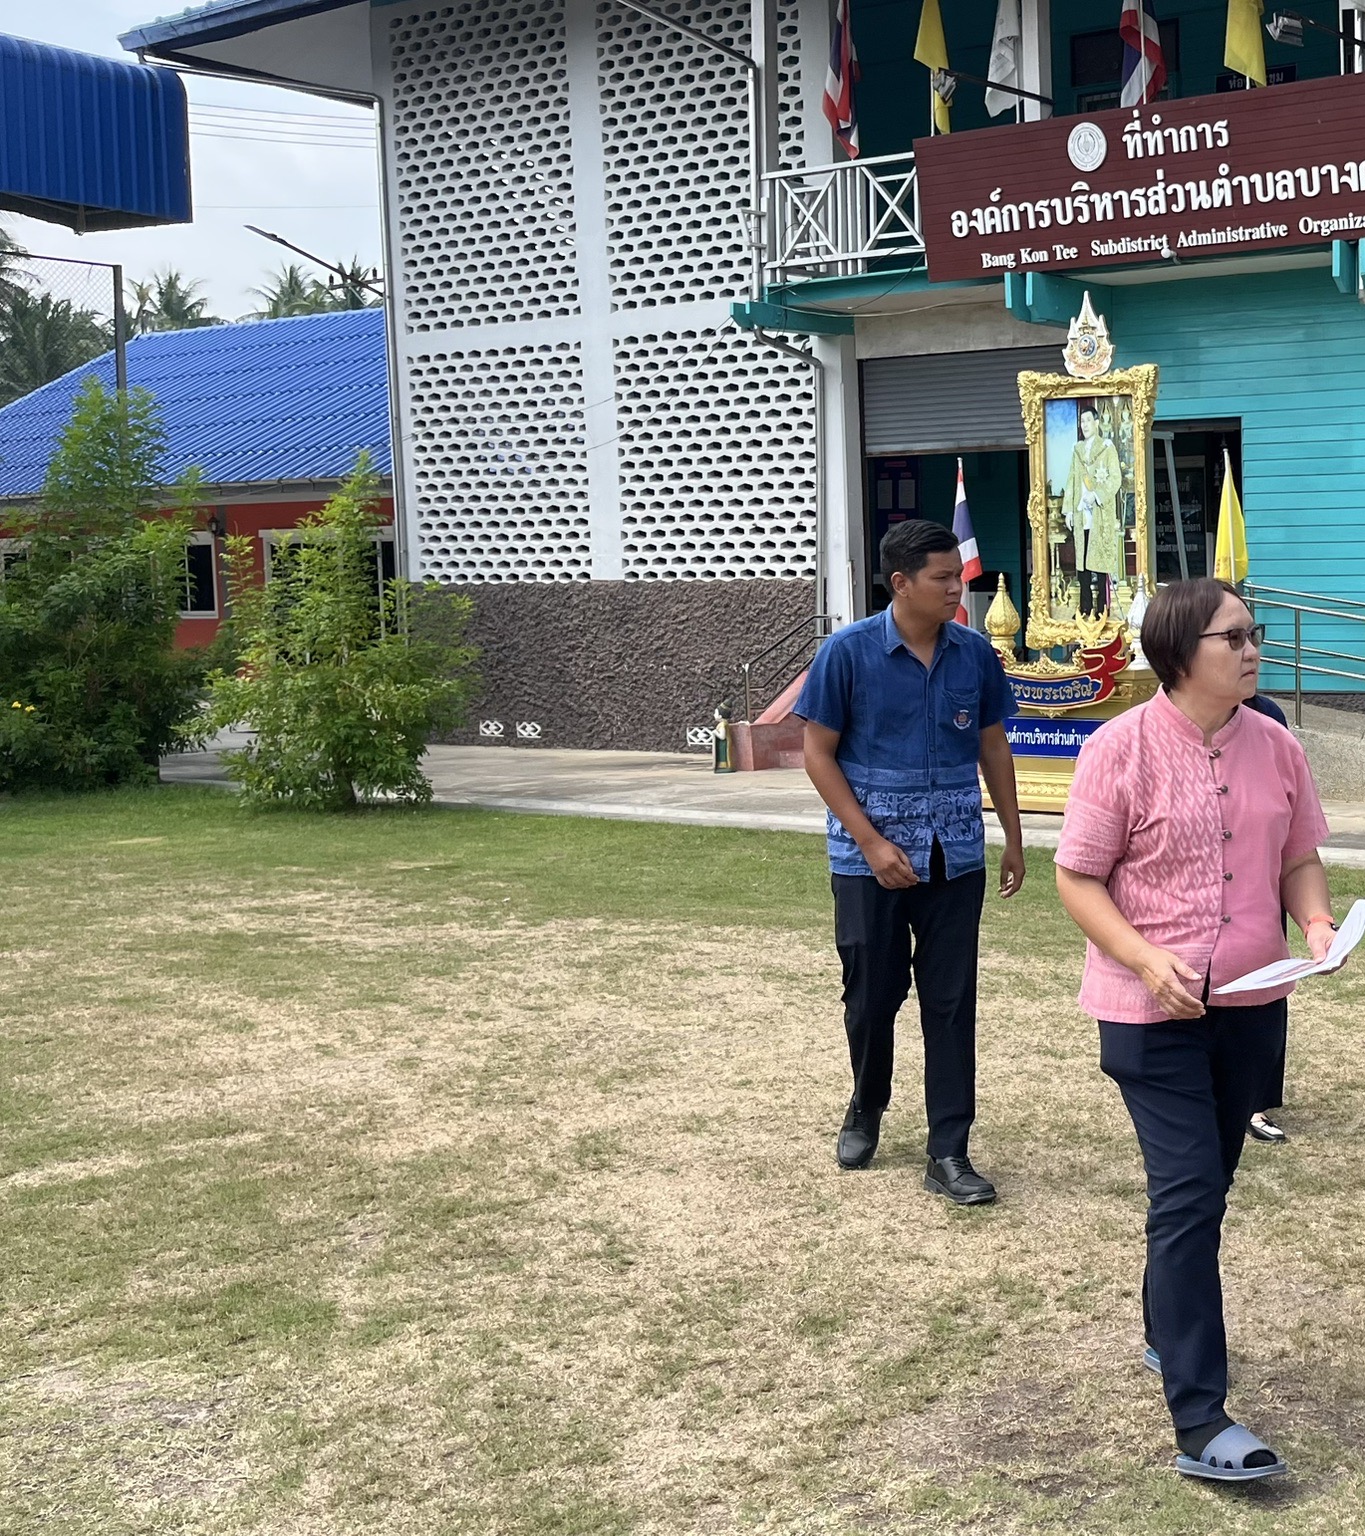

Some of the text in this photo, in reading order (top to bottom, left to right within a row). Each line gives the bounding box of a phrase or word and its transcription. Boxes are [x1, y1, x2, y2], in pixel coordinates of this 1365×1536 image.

[1122, 110, 1229, 160] ที่ทำการ
[981, 251, 1016, 270] Bang
[1020, 246, 1049, 264] Kon
[1053, 244, 1078, 261] Tee
[1091, 233, 1169, 257] Subdistrict
[1177, 221, 1288, 247] Administrative
